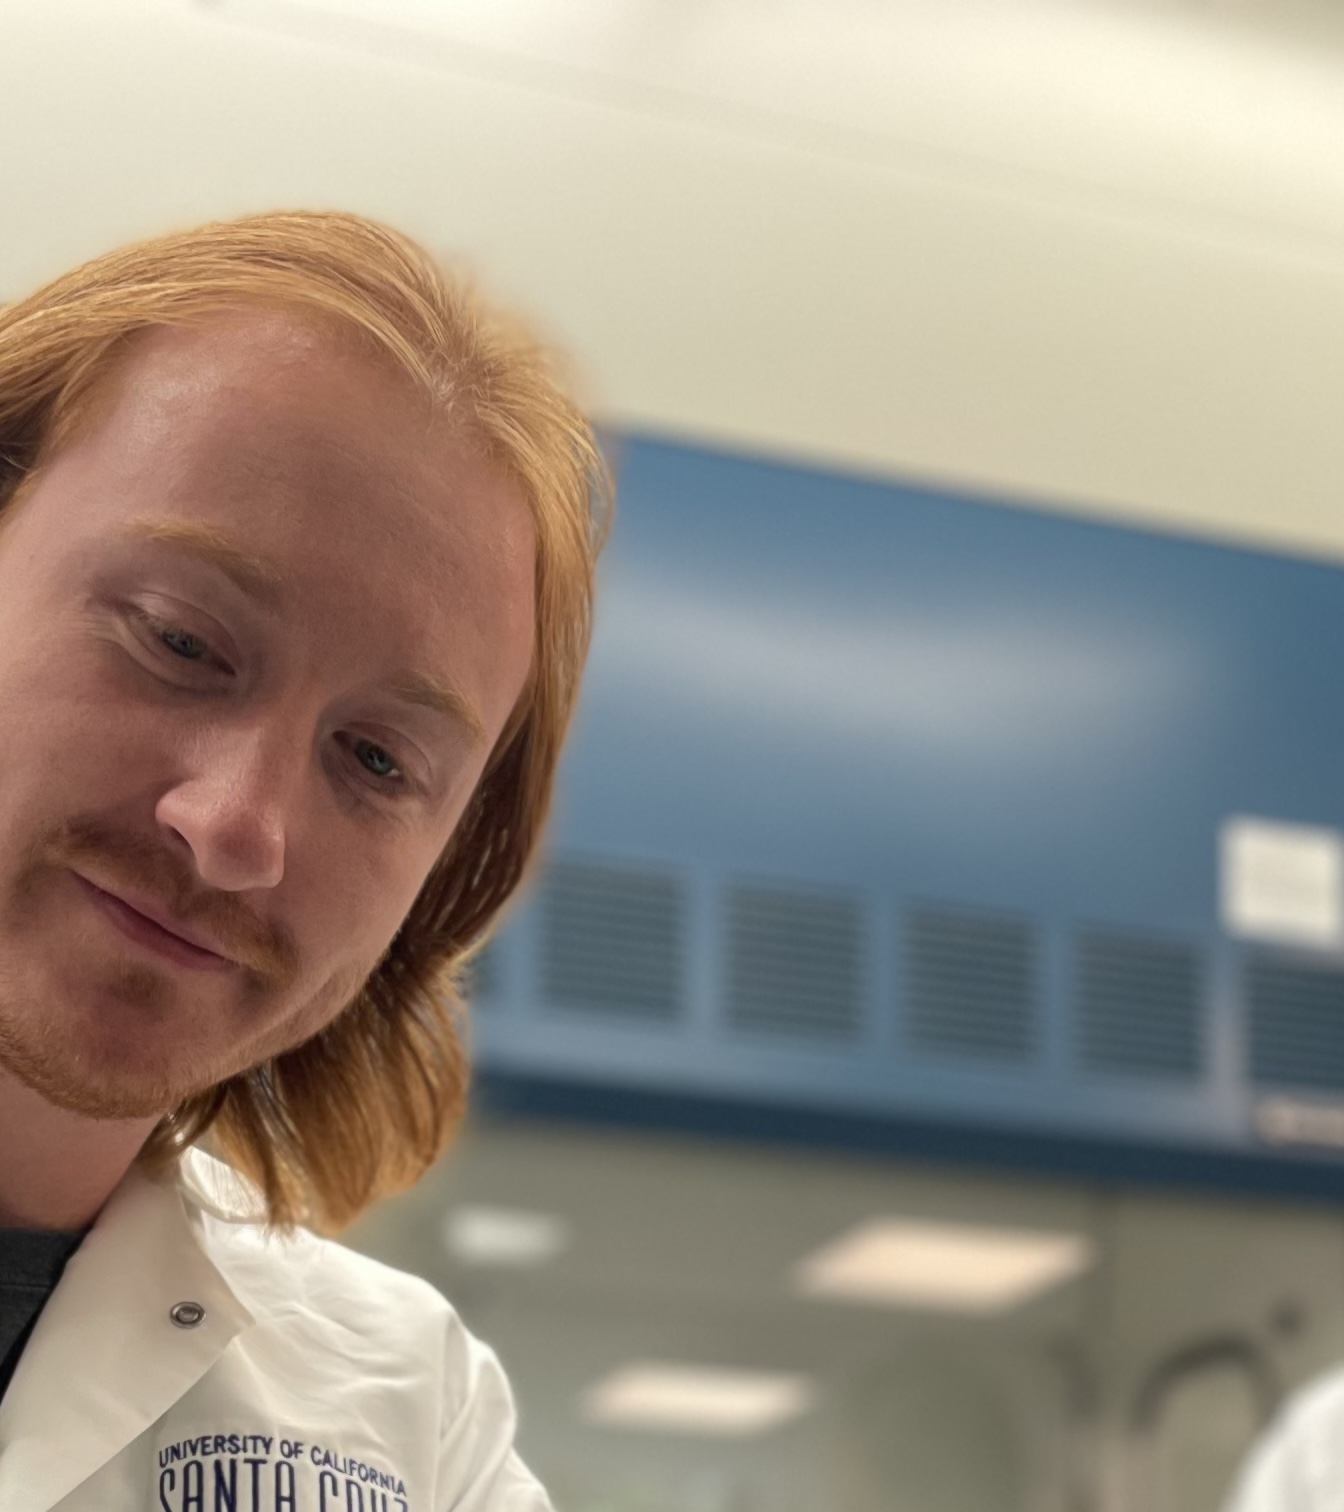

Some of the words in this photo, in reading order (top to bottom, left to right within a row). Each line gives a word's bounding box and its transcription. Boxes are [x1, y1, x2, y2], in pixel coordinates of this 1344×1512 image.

[159, 1435, 273, 1468] UNIVERSITY
[279, 1440, 304, 1459] OF
[310, 1446, 407, 1496] CALIFORNIA
